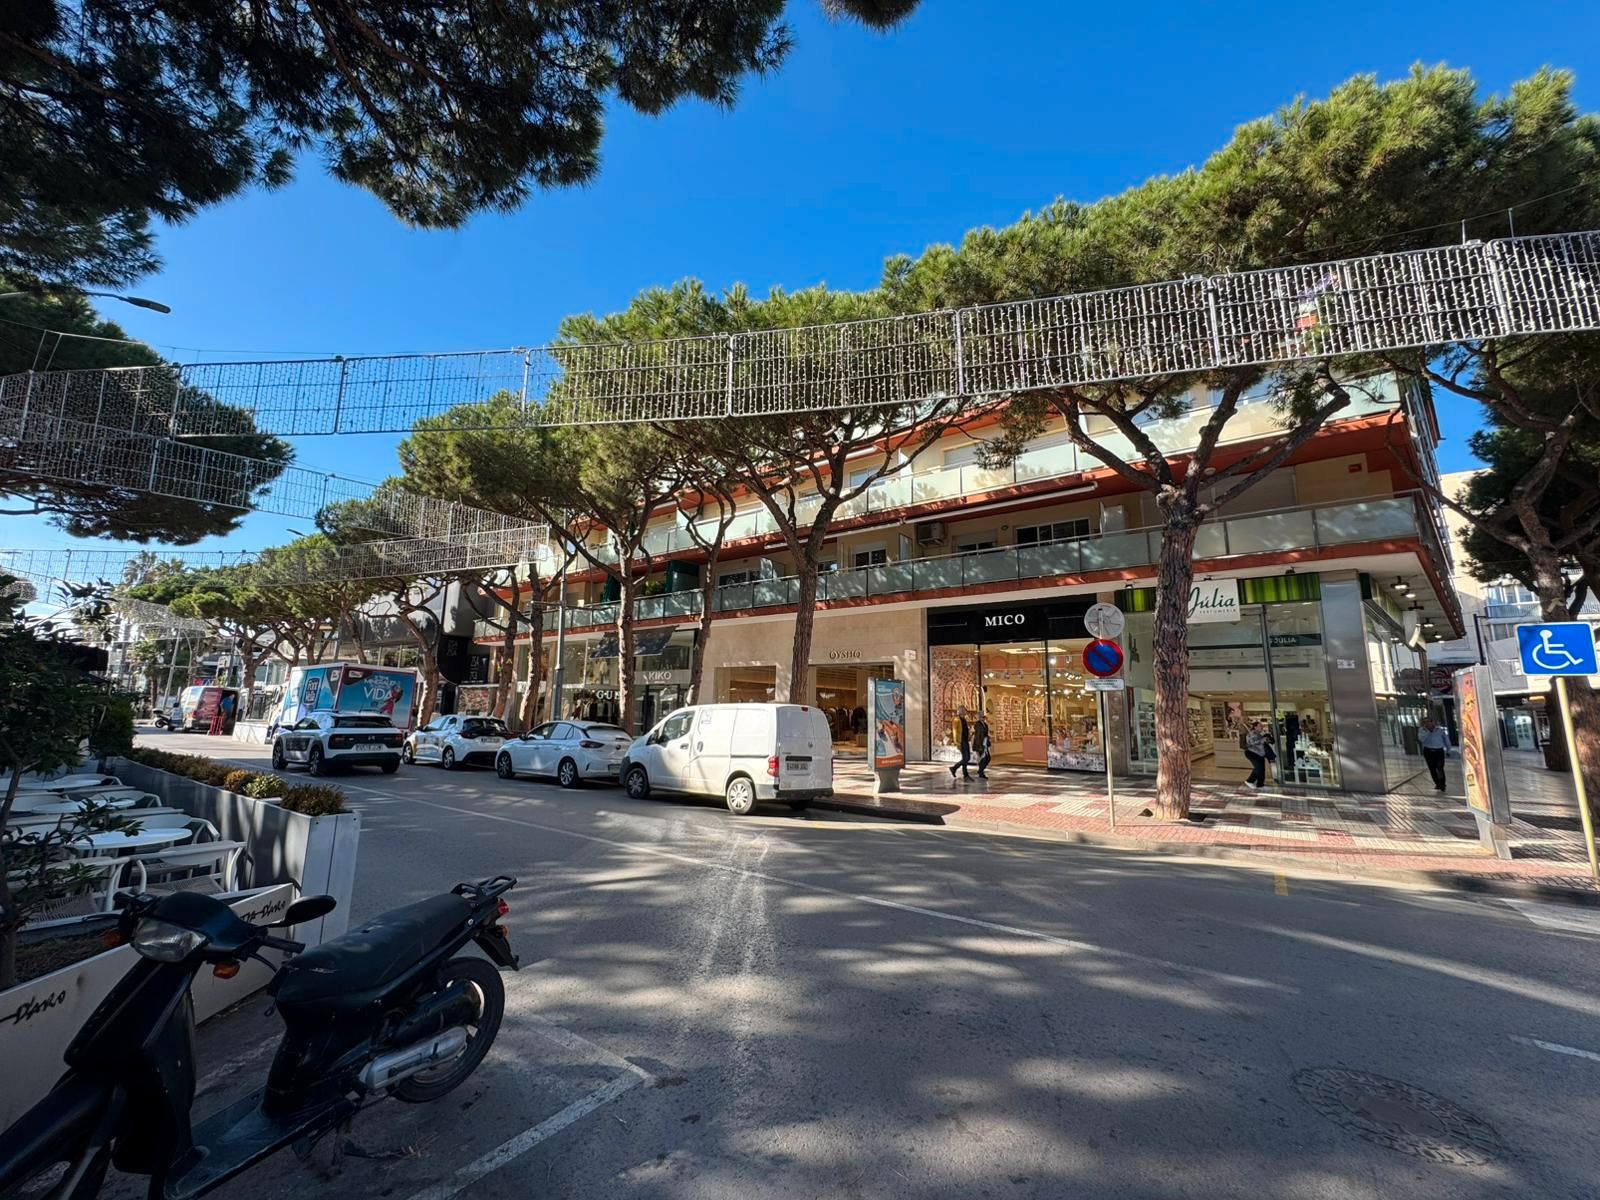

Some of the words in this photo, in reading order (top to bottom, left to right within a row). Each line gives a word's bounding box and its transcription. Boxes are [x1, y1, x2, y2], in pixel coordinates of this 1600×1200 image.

[1187, 586, 1236, 619] Júlia
[984, 613, 1025, 627] MICO
[828, 648, 862, 660] OYSHO
[648, 671, 672, 681] KIKO
[363, 686, 392, 700] VIDA
